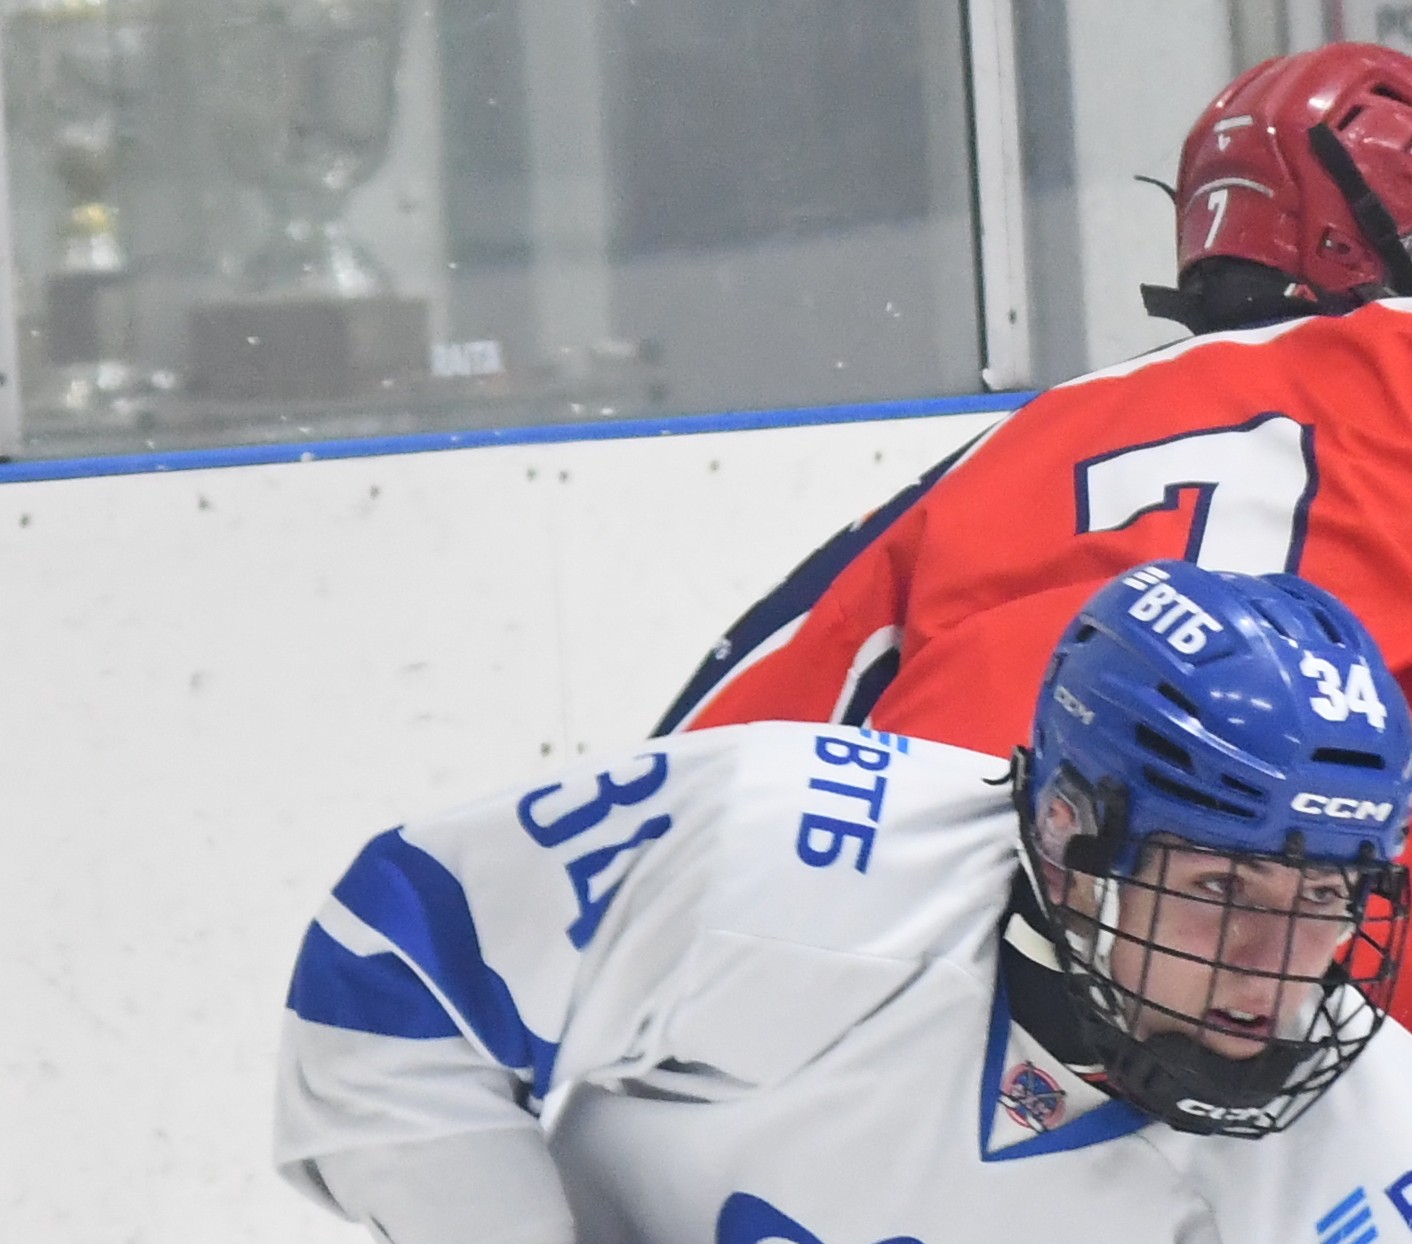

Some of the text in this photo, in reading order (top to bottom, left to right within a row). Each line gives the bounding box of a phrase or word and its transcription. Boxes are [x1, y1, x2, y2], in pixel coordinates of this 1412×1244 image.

[1207, 189, 1229, 250] 7
[1074, 411, 1320, 577] 7
[1128, 583, 1224, 655] ВТБ
[1300, 649, 1388, 733] 34
[796, 736, 891, 875] ВТБ
[1291, 792, 1394, 822] CCM
[516, 752, 673, 951] 34
